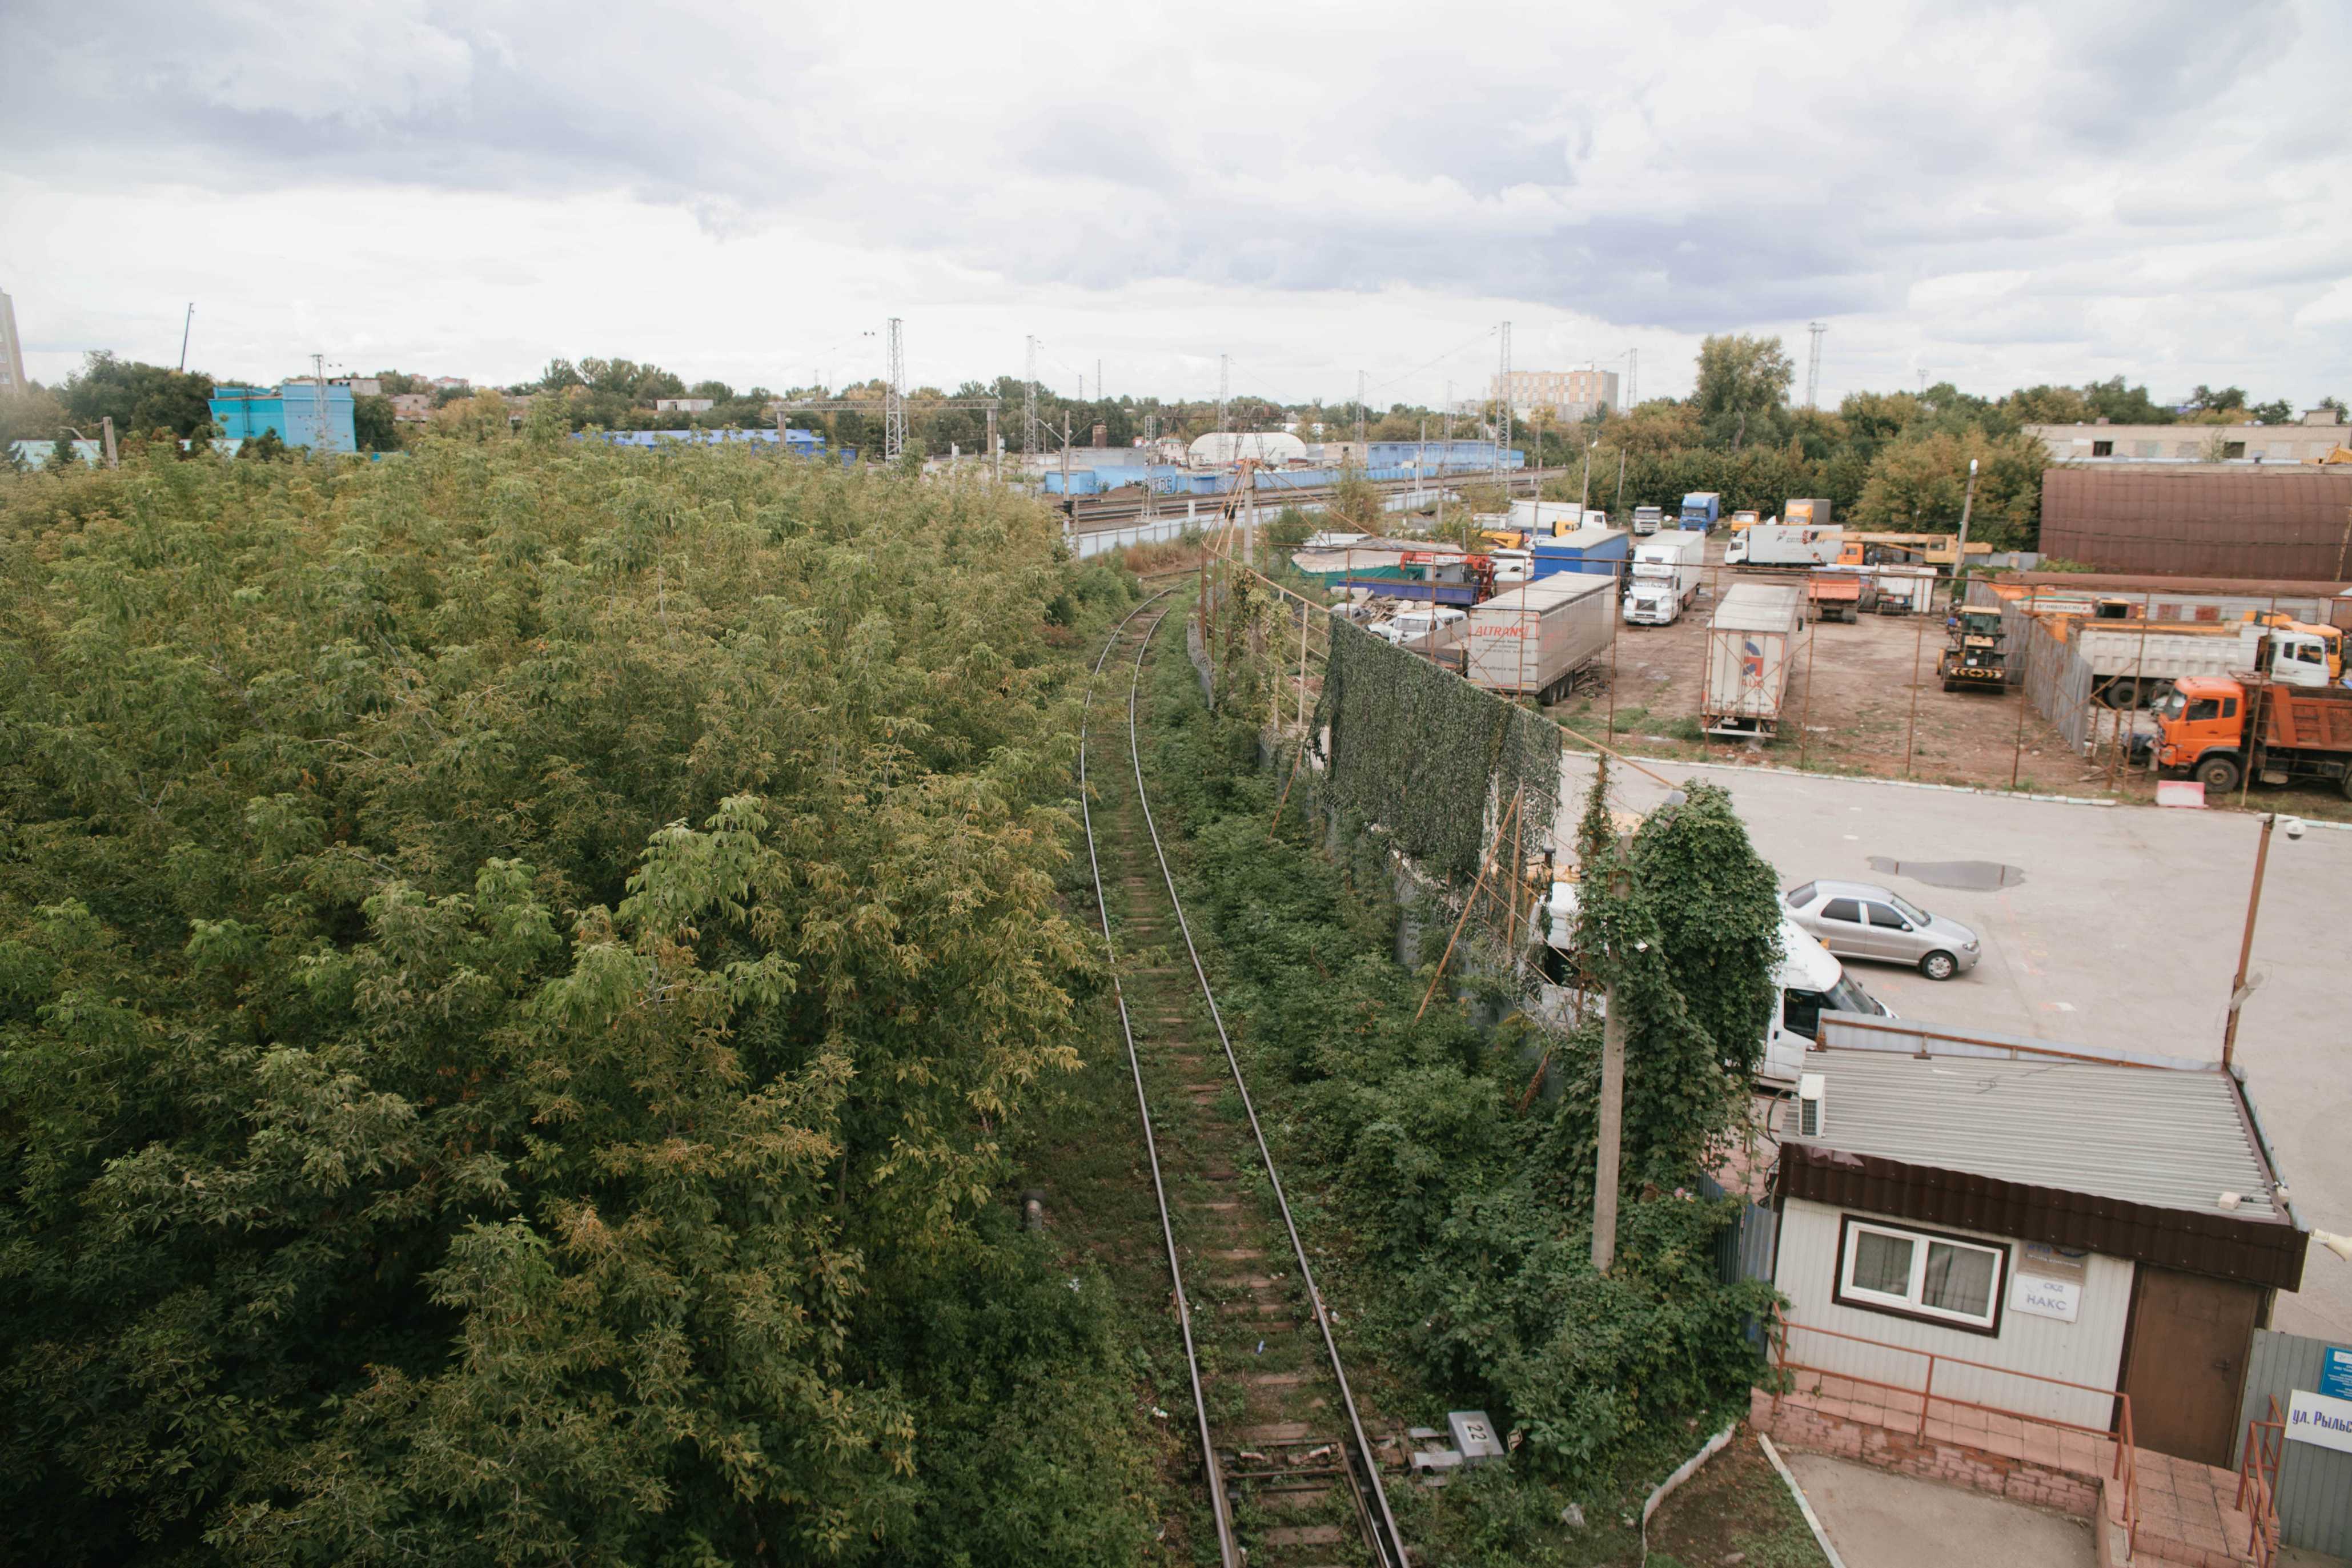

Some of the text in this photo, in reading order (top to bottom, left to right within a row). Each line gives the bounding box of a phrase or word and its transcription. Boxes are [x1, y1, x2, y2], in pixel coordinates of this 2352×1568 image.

[2027, 1294, 2066, 1310] НАКС
[2292, 1409, 2310, 1425] ул.
[1467, 1425, 1487, 1440] 22
